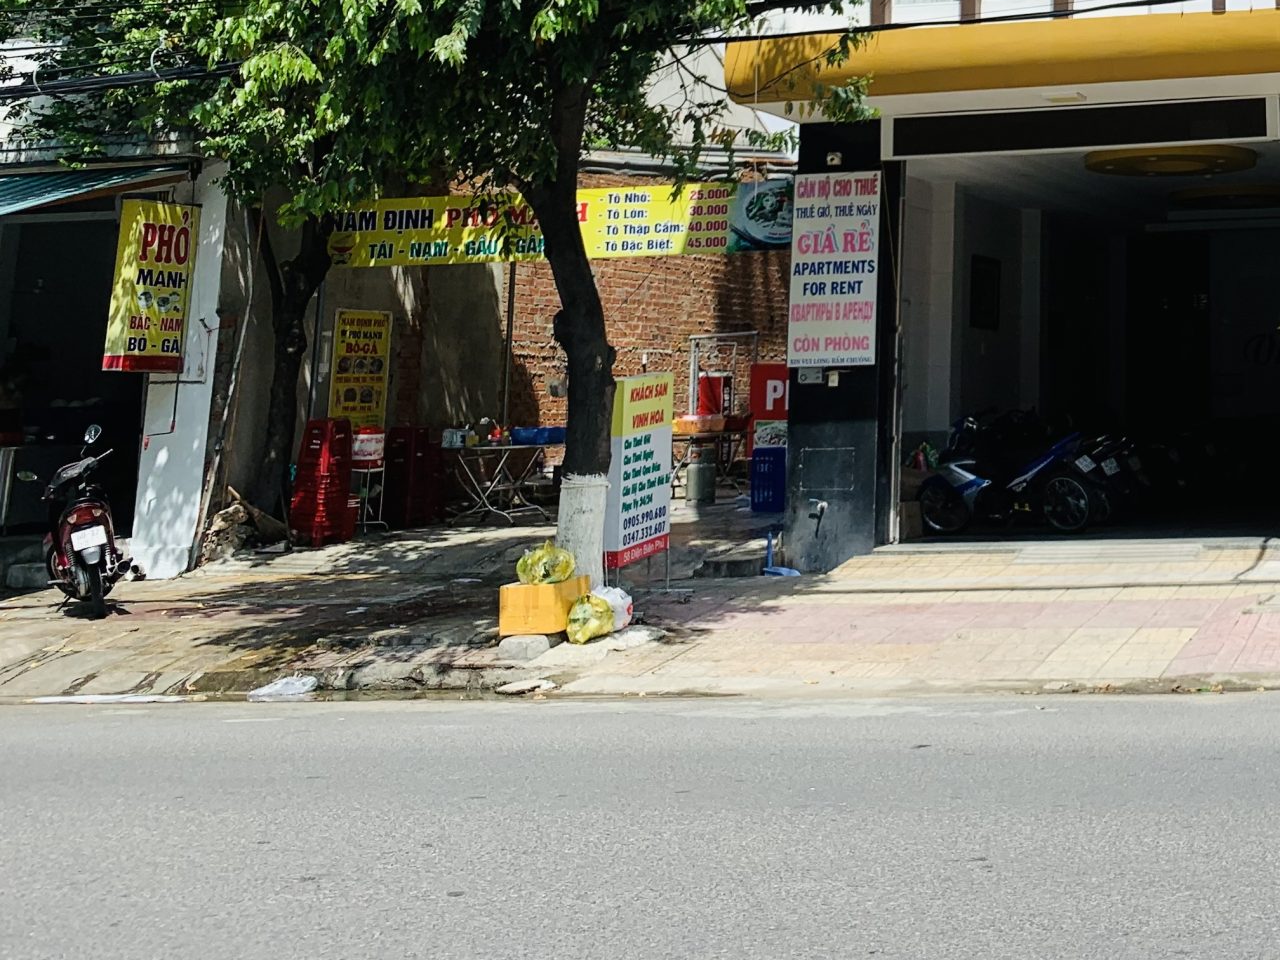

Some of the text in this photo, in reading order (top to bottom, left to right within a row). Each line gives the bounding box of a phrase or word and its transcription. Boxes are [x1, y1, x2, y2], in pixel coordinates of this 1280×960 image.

[689, 189, 729, 200] 25.000
[833, 179, 852, 197] CHO
[690, 205, 728, 216] 30.000
[334, 211, 377, 232] NAM
[384, 209, 434, 234] ĐỊNH
[688, 220, 727, 232] 40.000
[369, 240, 393, 259] TÁI
[410, 242, 448, 260] NẠM
[687, 236, 727, 248] 45.000
[797, 226, 837, 254] GIÁ
[793, 260, 875, 276] APARTMENTS
[803, 280, 863, 296] FOR RENT
[790, 301, 874, 323] КВАРТИРЫ В АРЕНДУ
[630, 382, 668, 402] KHÁCH SẠN
[632, 409, 664, 429] VINH HOA
[623, 505, 666, 530] 0905.990.680
[623, 521, 666, 546] 0347.332.607
